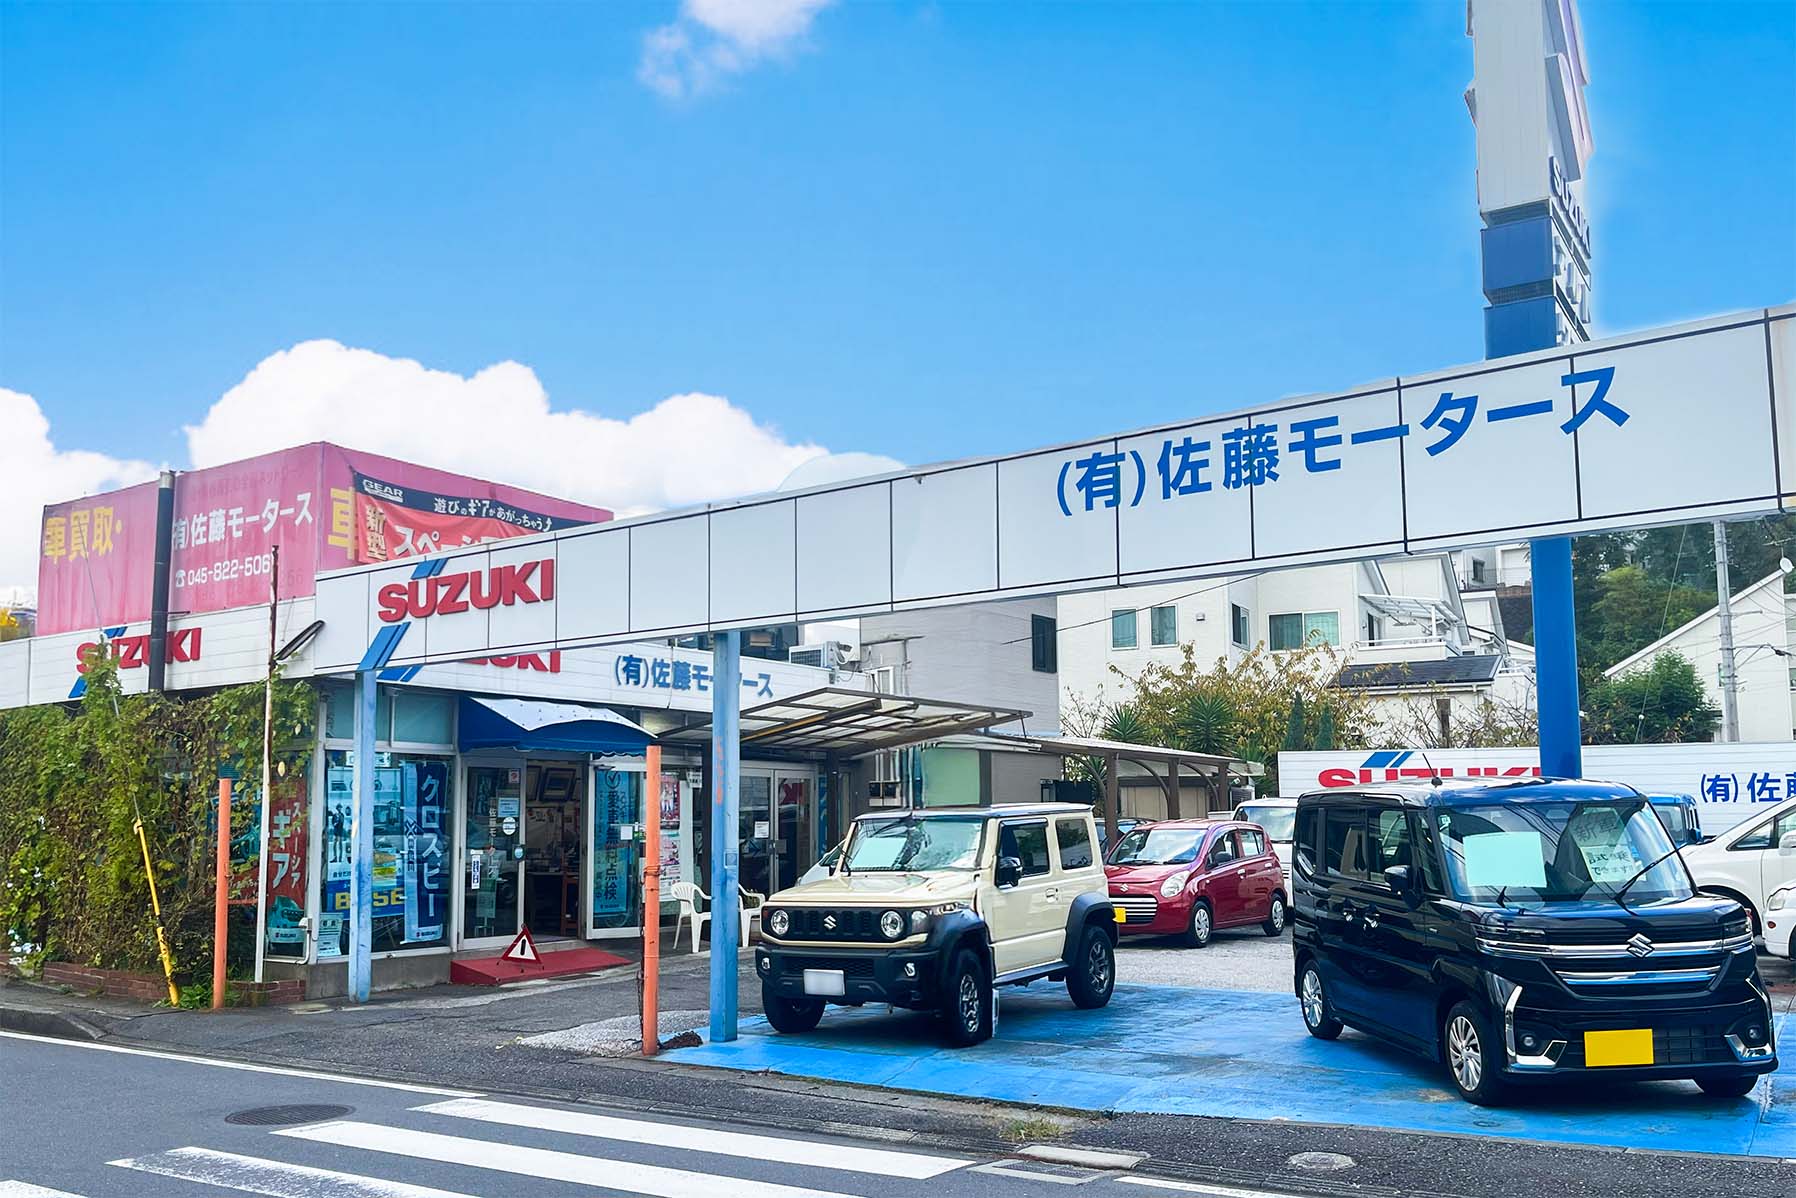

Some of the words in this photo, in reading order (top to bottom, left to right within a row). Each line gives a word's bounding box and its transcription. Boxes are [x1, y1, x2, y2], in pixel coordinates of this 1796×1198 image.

[1056, 366, 1631, 516] (有)佐藤モータース
[362, 479, 403, 497] GEAR
[172, 492, 314, 551] 有)佐藤モータース
[188, 554, 274, 586] 045-822-506
[378, 559, 554, 622] SUZUKI
[421, 774, 443, 918] クロスビー
[335, 888, 405, 911] BSE
